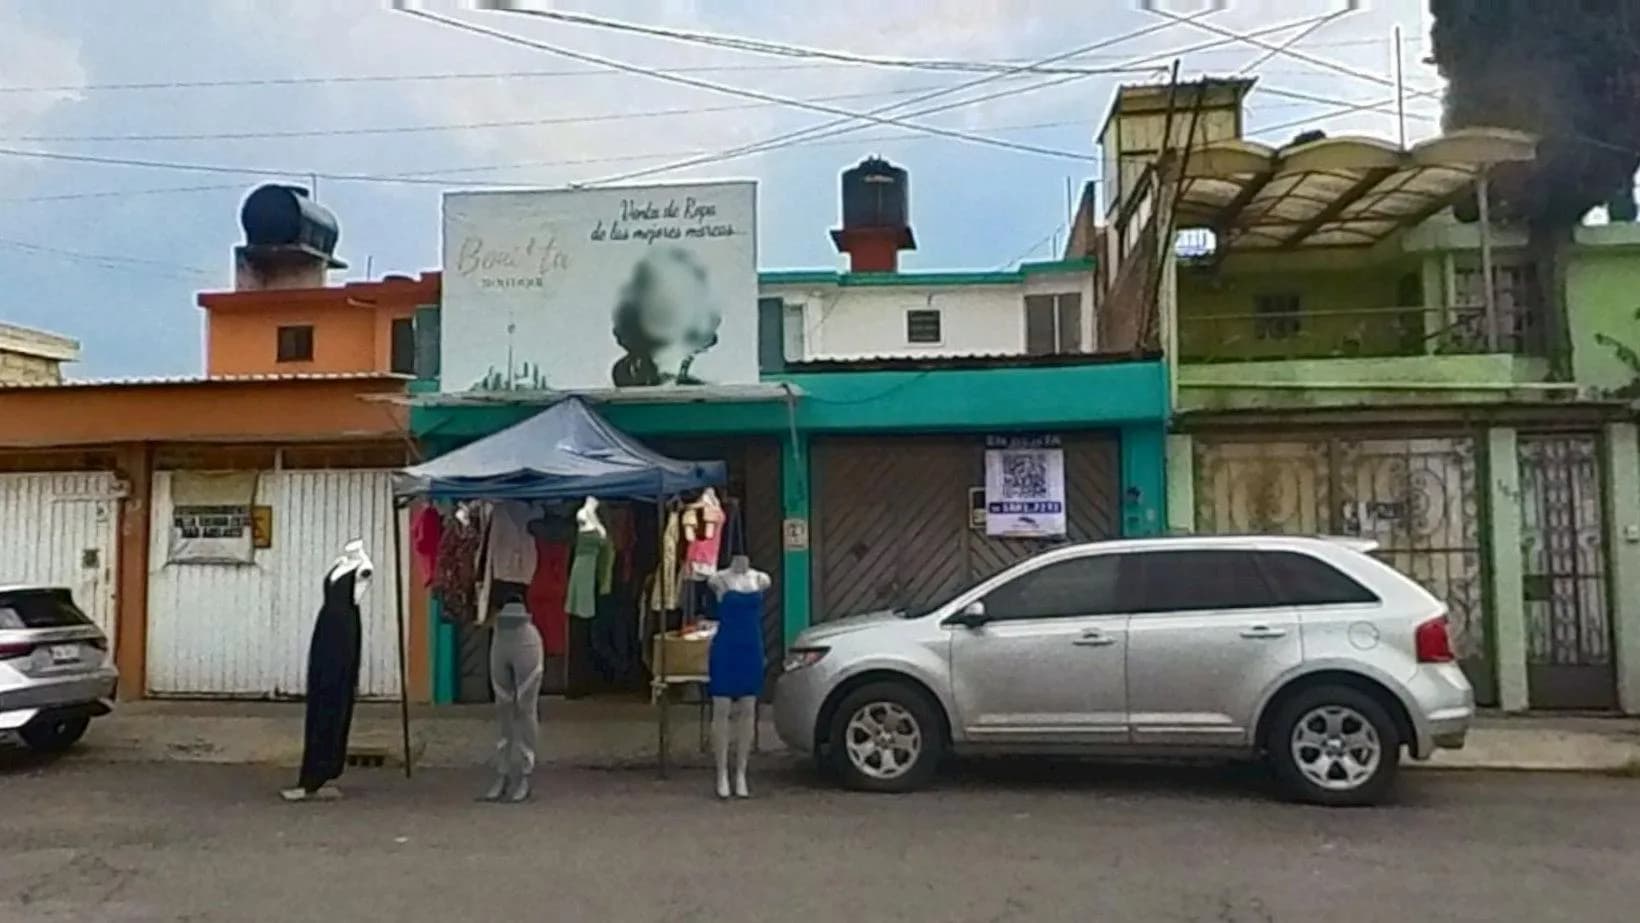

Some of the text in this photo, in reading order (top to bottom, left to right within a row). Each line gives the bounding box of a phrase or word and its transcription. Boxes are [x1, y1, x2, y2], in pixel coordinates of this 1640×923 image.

[621, 196, 717, 224] Venta de Ropa
[590, 220, 606, 241] de
[610, 220, 629, 241] las
[632, 227, 682, 246] mejores
